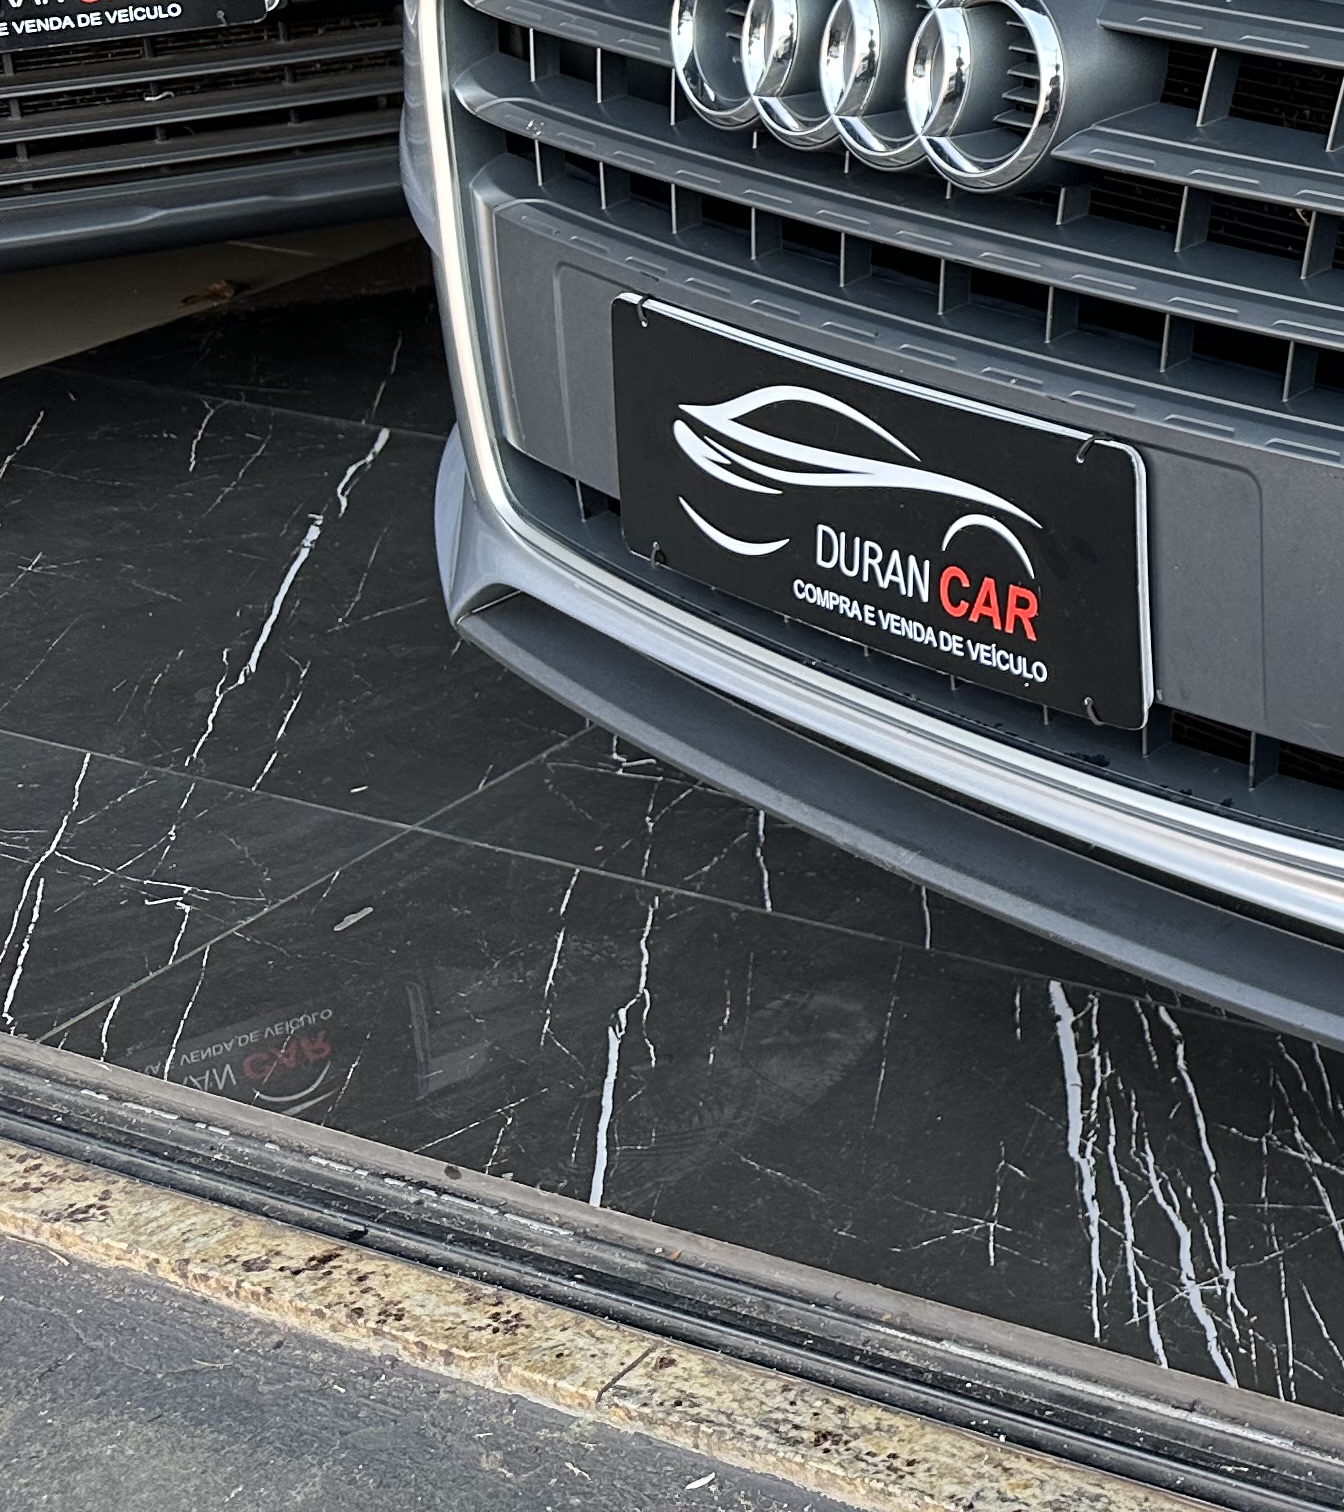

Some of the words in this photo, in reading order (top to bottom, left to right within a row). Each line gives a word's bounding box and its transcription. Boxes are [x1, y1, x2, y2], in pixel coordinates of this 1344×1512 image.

[12, 16, 75, 35] VENDA
[77, 12, 103, 28] DE
[104, 3, 183, 24] VEÍCULO
[792, 578, 862, 622] COMPRA
[863, 604, 877, 627] E
[877, 609, 938, 649] VENDA
[938, 630, 965, 657] DE
[966, 639, 1048, 683] VEÍCULO
[815, 523, 931, 603] DURAN
[939, 565, 1040, 642] CAR
